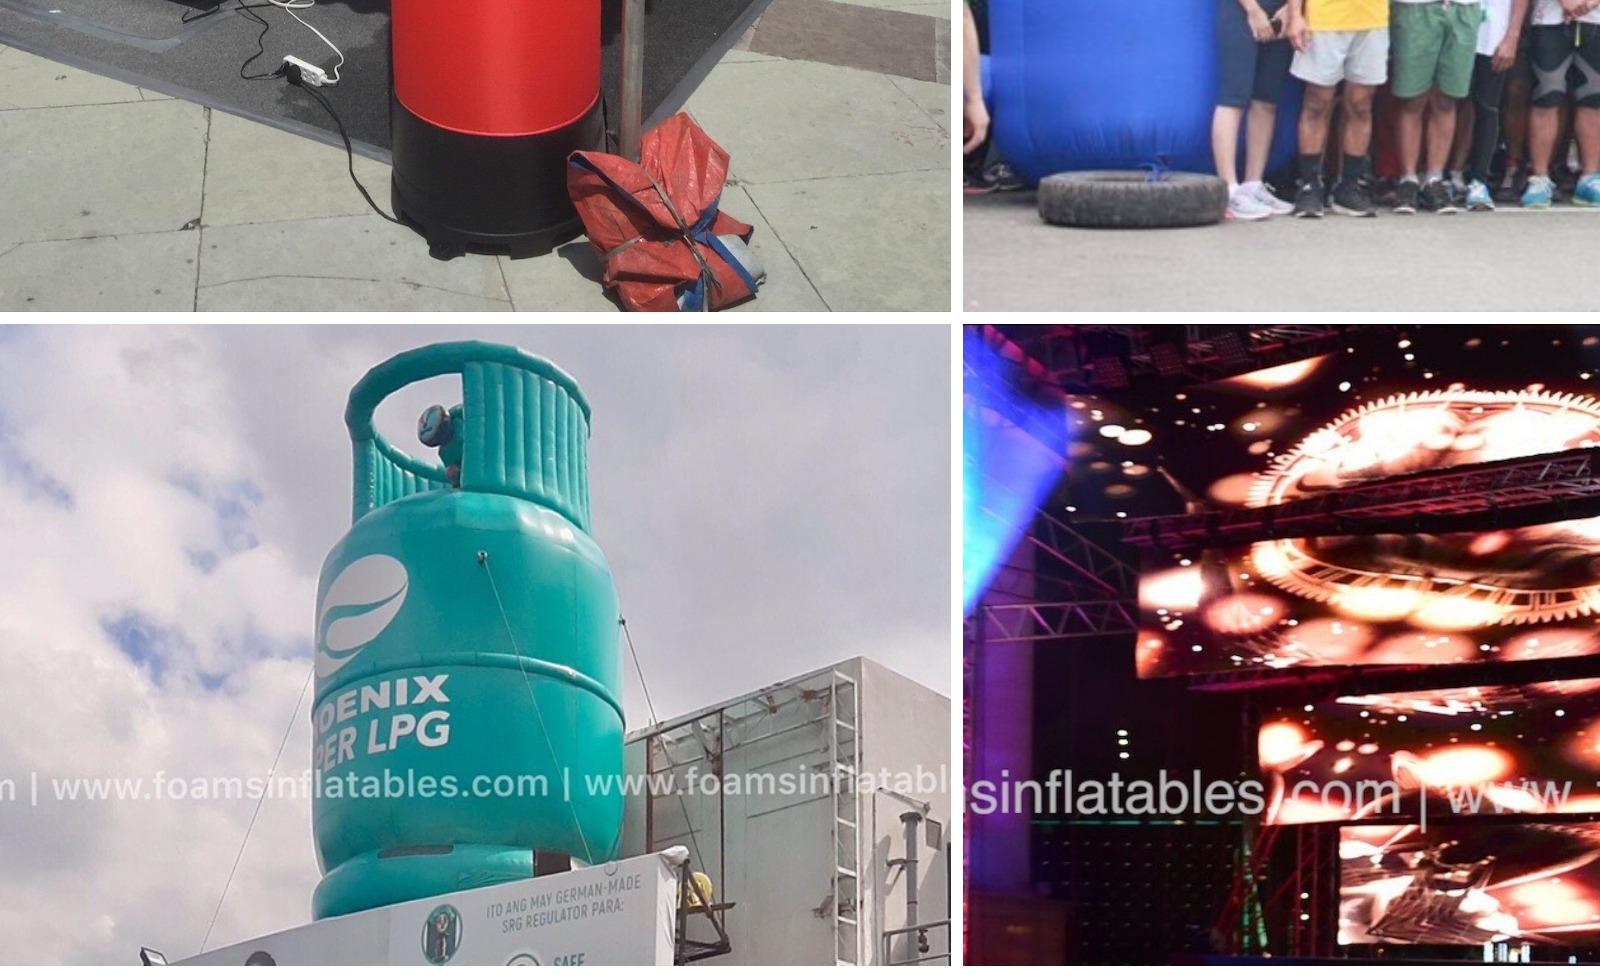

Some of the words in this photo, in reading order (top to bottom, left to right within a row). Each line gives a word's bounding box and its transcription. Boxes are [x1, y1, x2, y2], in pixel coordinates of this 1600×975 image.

[367, 710, 451, 755] LPG
[487, 904, 503, 919] ITO
[506, 899, 527, 916] ANG
[530, 892, 552, 911] MAY
[555, 874, 642, 907] GERMAN-MADE
[502, 915, 522, 934] SRG
[526, 903, 588, 932] REGULATOR
